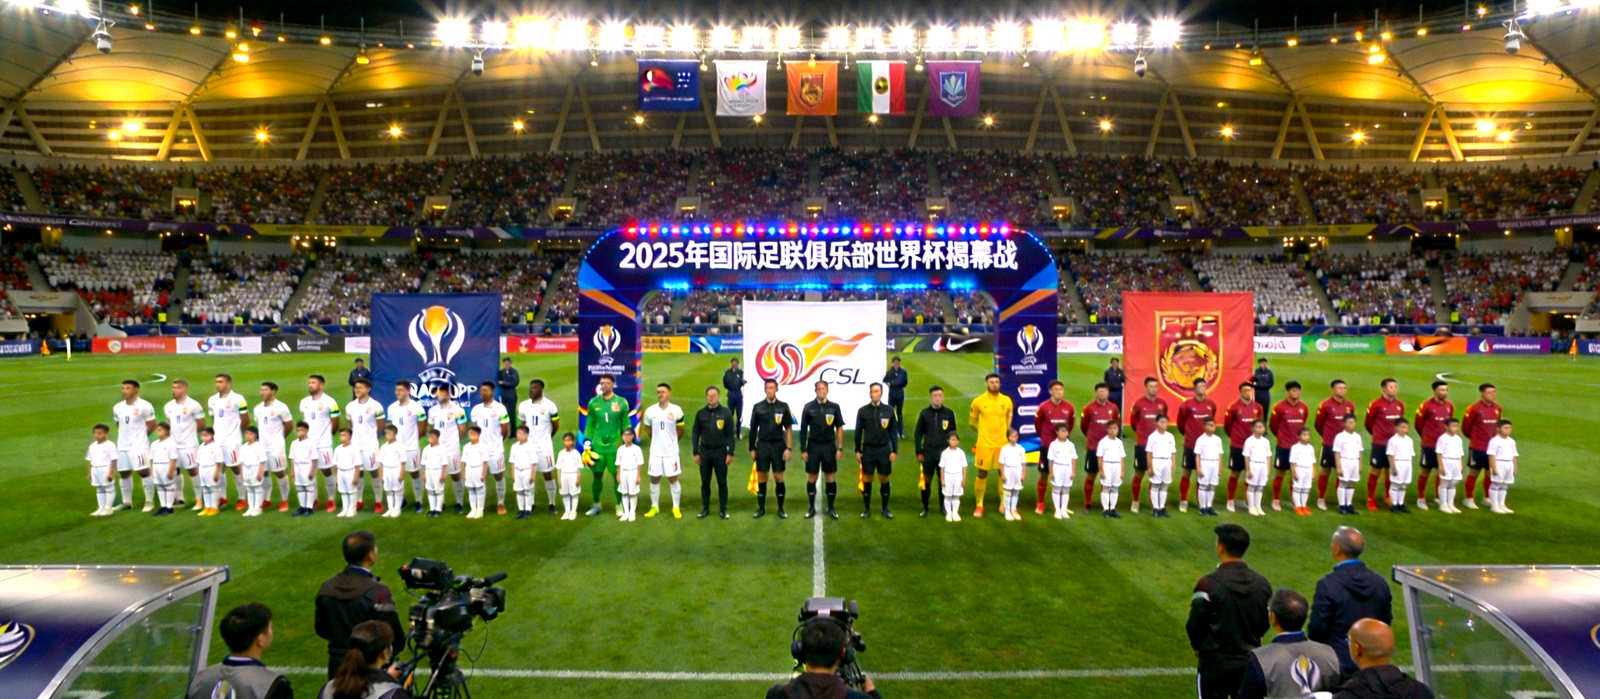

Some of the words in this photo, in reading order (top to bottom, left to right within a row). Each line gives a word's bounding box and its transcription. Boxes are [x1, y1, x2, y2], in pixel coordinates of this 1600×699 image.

[619, 240, 1019, 271] 2025年国际足联俱乐部世界杯揭幕战
[819, 367, 866, 385] CSL
